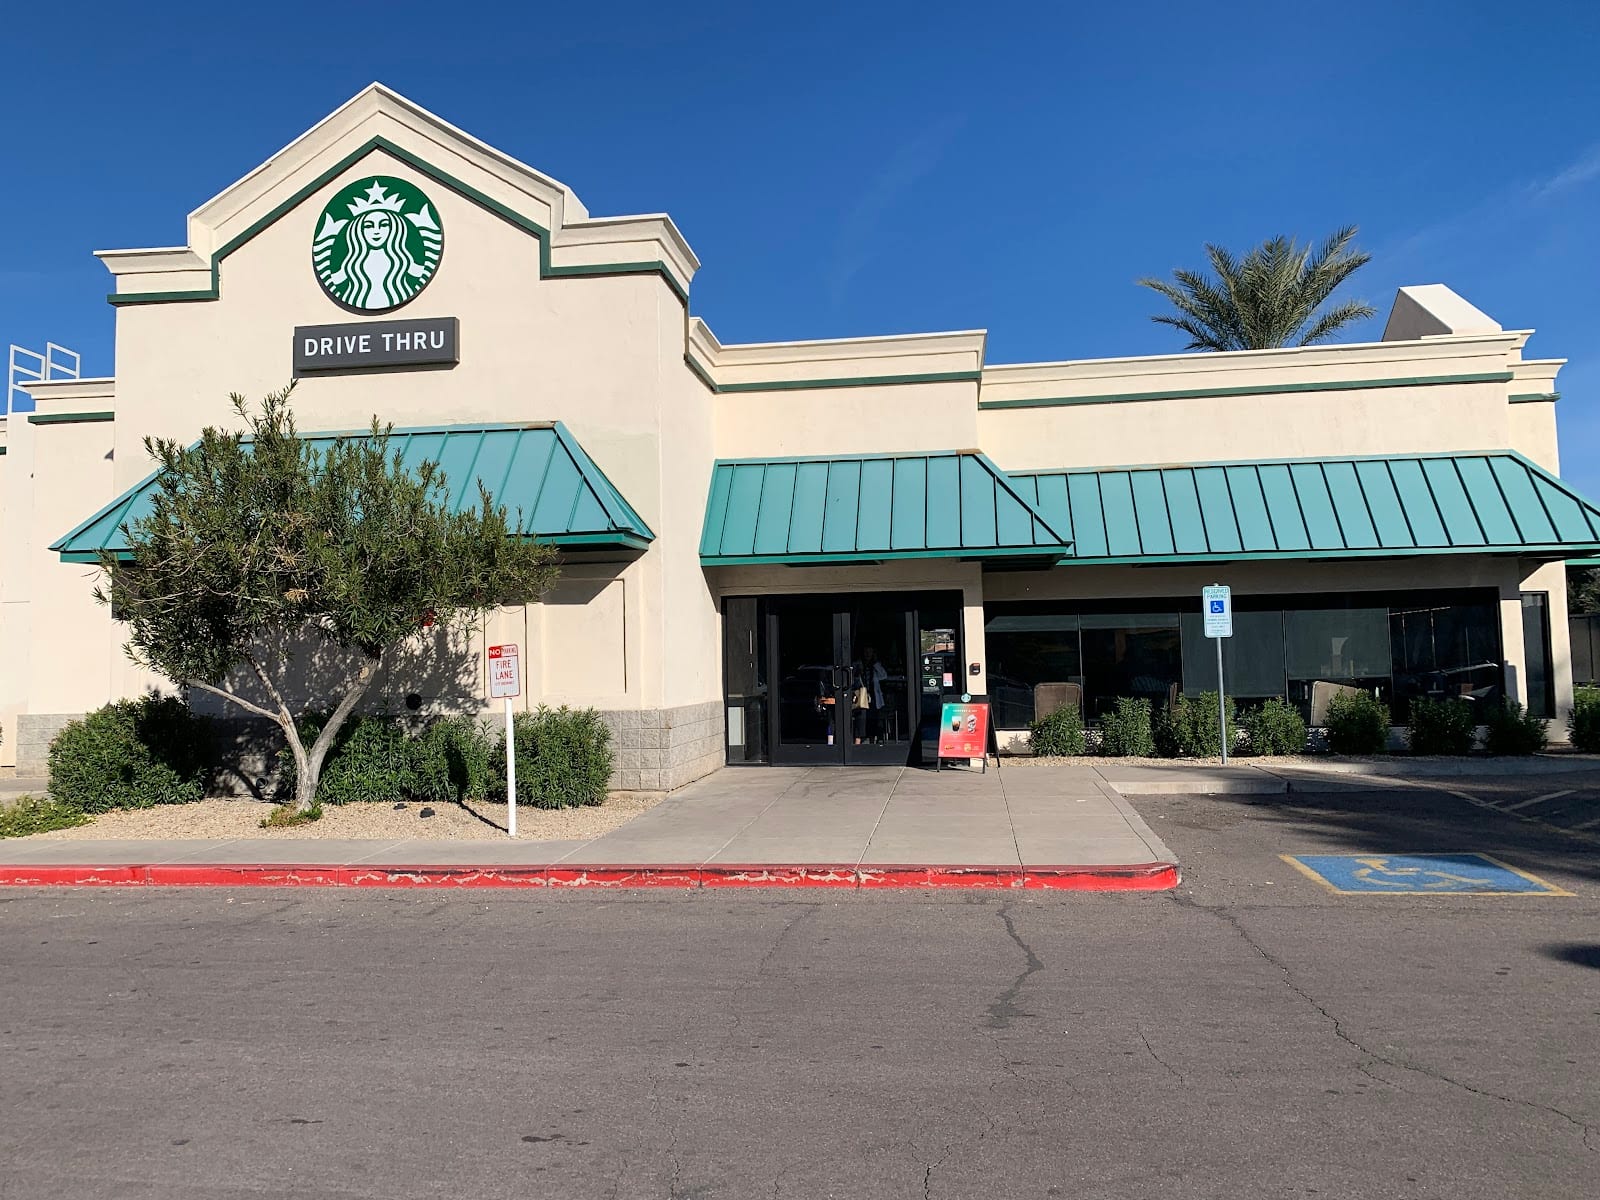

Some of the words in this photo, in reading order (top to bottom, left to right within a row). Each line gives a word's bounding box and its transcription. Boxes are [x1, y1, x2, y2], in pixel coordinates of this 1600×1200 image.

[304, 334, 371, 357] DRIVE
[381, 330, 445, 352] THRU
[489, 648, 501, 656] NO
[496, 659, 512, 670] FIRE
[495, 670, 514, 680] LANE
